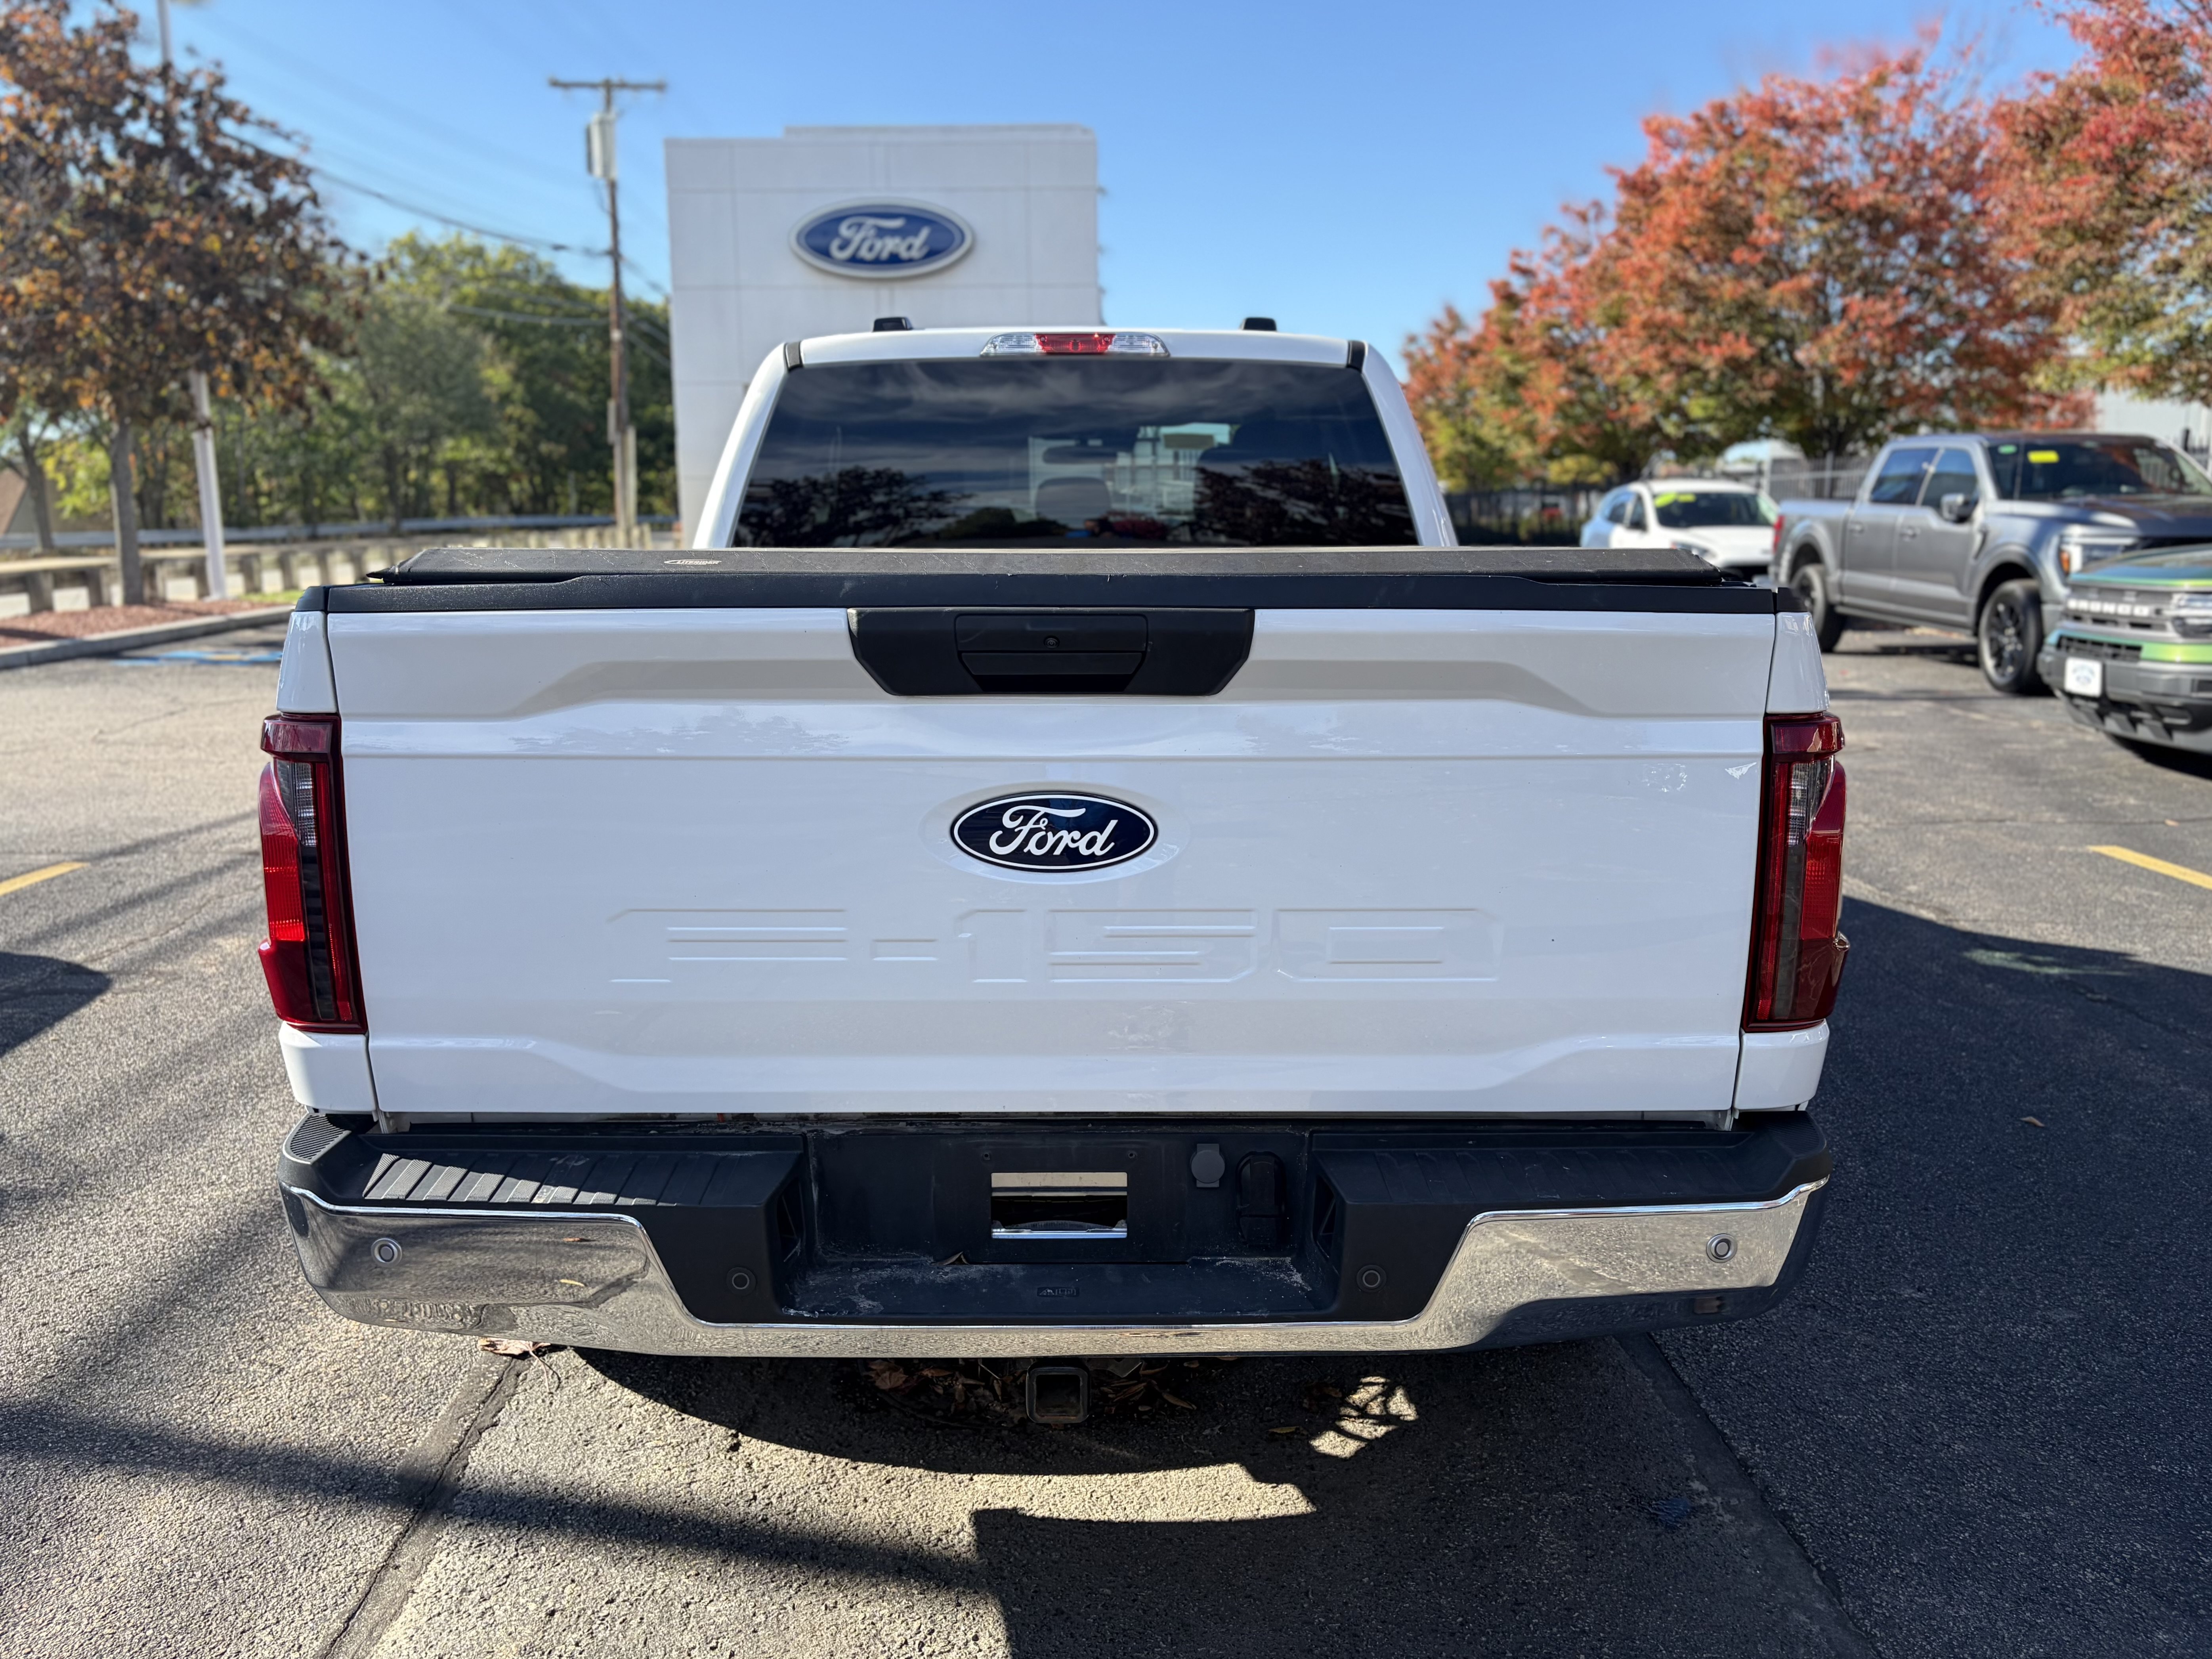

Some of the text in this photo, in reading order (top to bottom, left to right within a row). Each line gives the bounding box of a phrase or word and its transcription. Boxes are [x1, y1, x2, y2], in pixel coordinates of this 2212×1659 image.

[829, 216, 931, 261] Ford
[2067, 598, 2150, 617] BRONCO
[989, 805, 1118, 856] Ford
[606, 908, 1501, 984] F-150
